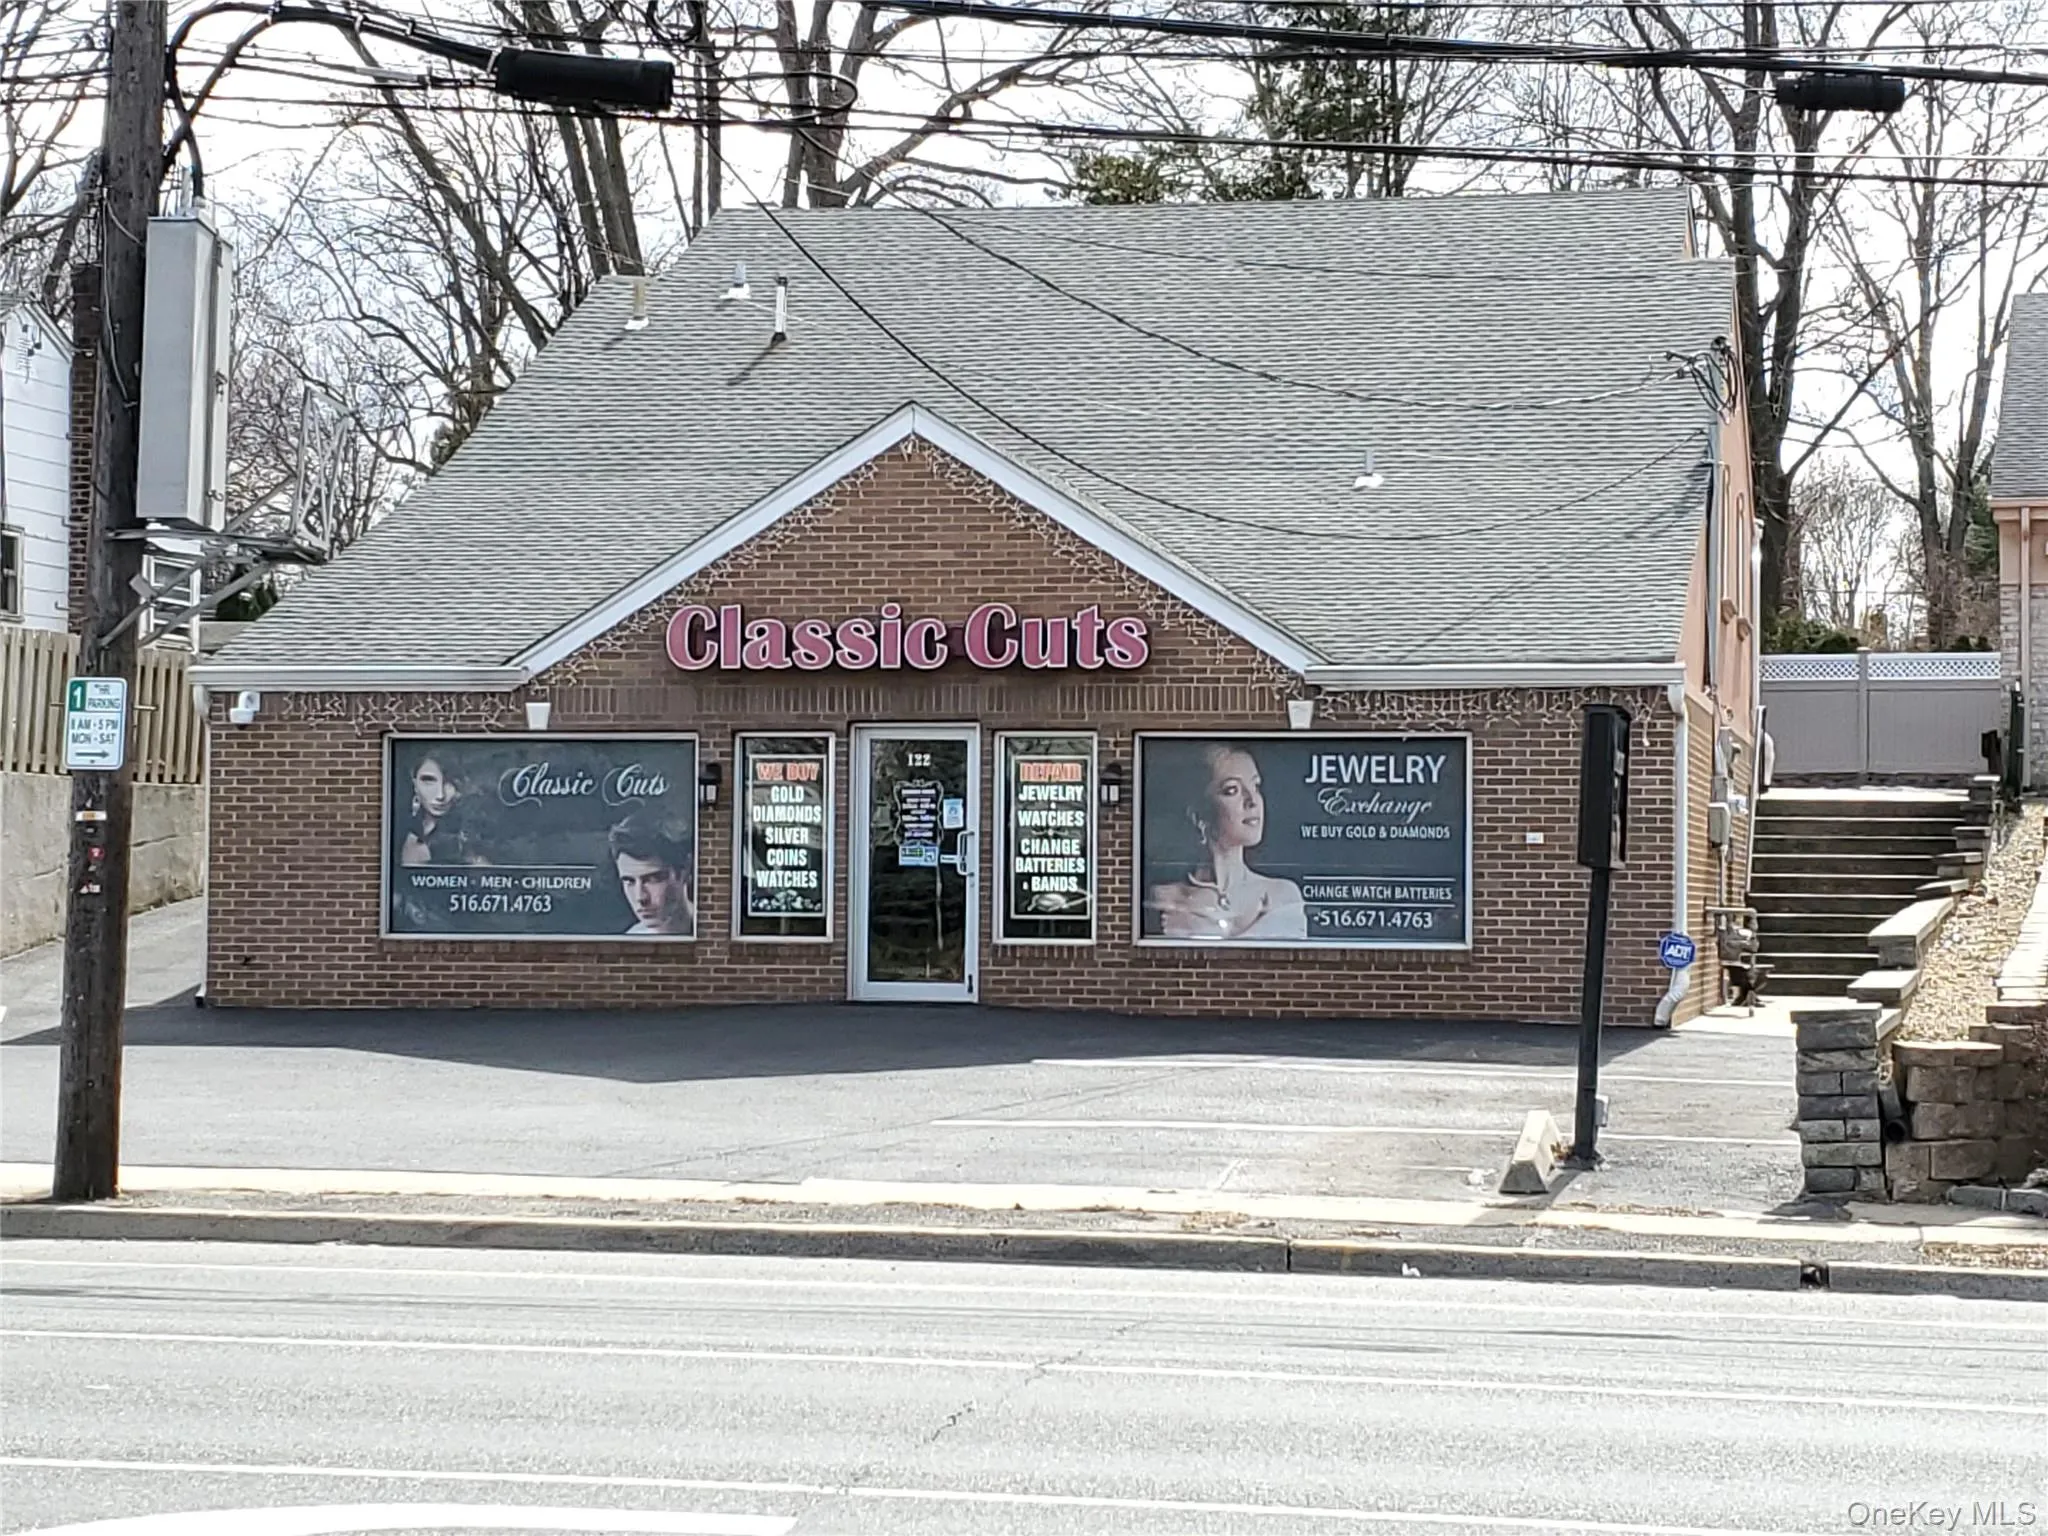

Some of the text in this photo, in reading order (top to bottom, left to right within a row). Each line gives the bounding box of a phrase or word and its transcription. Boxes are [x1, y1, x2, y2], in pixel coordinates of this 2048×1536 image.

[666, 602, 1149, 670] Classic Cuts
[73, 686, 82, 709] 1
[87, 698, 121, 709] PARKING
[78, 719, 92, 730] AM
[98, 719, 104, 730] 5
[106, 719, 119, 730] PM
[71, 732, 92, 744] MON
[99, 733, 116, 744] SAT
[908, 753, 931, 767] 122
[757, 763, 820, 780] WE BUY
[1305, 754, 1447, 784] JEWELRY
[498, 762, 670, 807] Classic Cuts
[1018, 785, 1084, 801] JEWELRY
[770, 785, 804, 803] GOLD
[753, 805, 822, 823] DIAMONDS
[1317, 787, 1433, 825] Exchange
[1018, 810, 1085, 827] WATCHES
[765, 827, 809, 845] SILVER
[1301, 825, 1450, 840] WE BUY GOLD & DIAMONDS
[1020, 838, 1081, 856] CHANGE
[766, 848, 807, 866] COINS
[1015, 857, 1085, 873] BATTERIES
[411, 875, 468, 888] WOMEN
[481, 876, 512, 888] MEN
[522, 877, 592, 889] CHILDREN
[756, 870, 818, 888] WATCHES
[1031, 876, 1078, 892] BANDS
[1303, 885, 1452, 900] CHANGE WATCH BATTERIES
[450, 894, 552, 912] 516.671.4763
[1320, 910, 1433, 928] 516.671.4763
[1665, 944, 1692, 959] ADT
